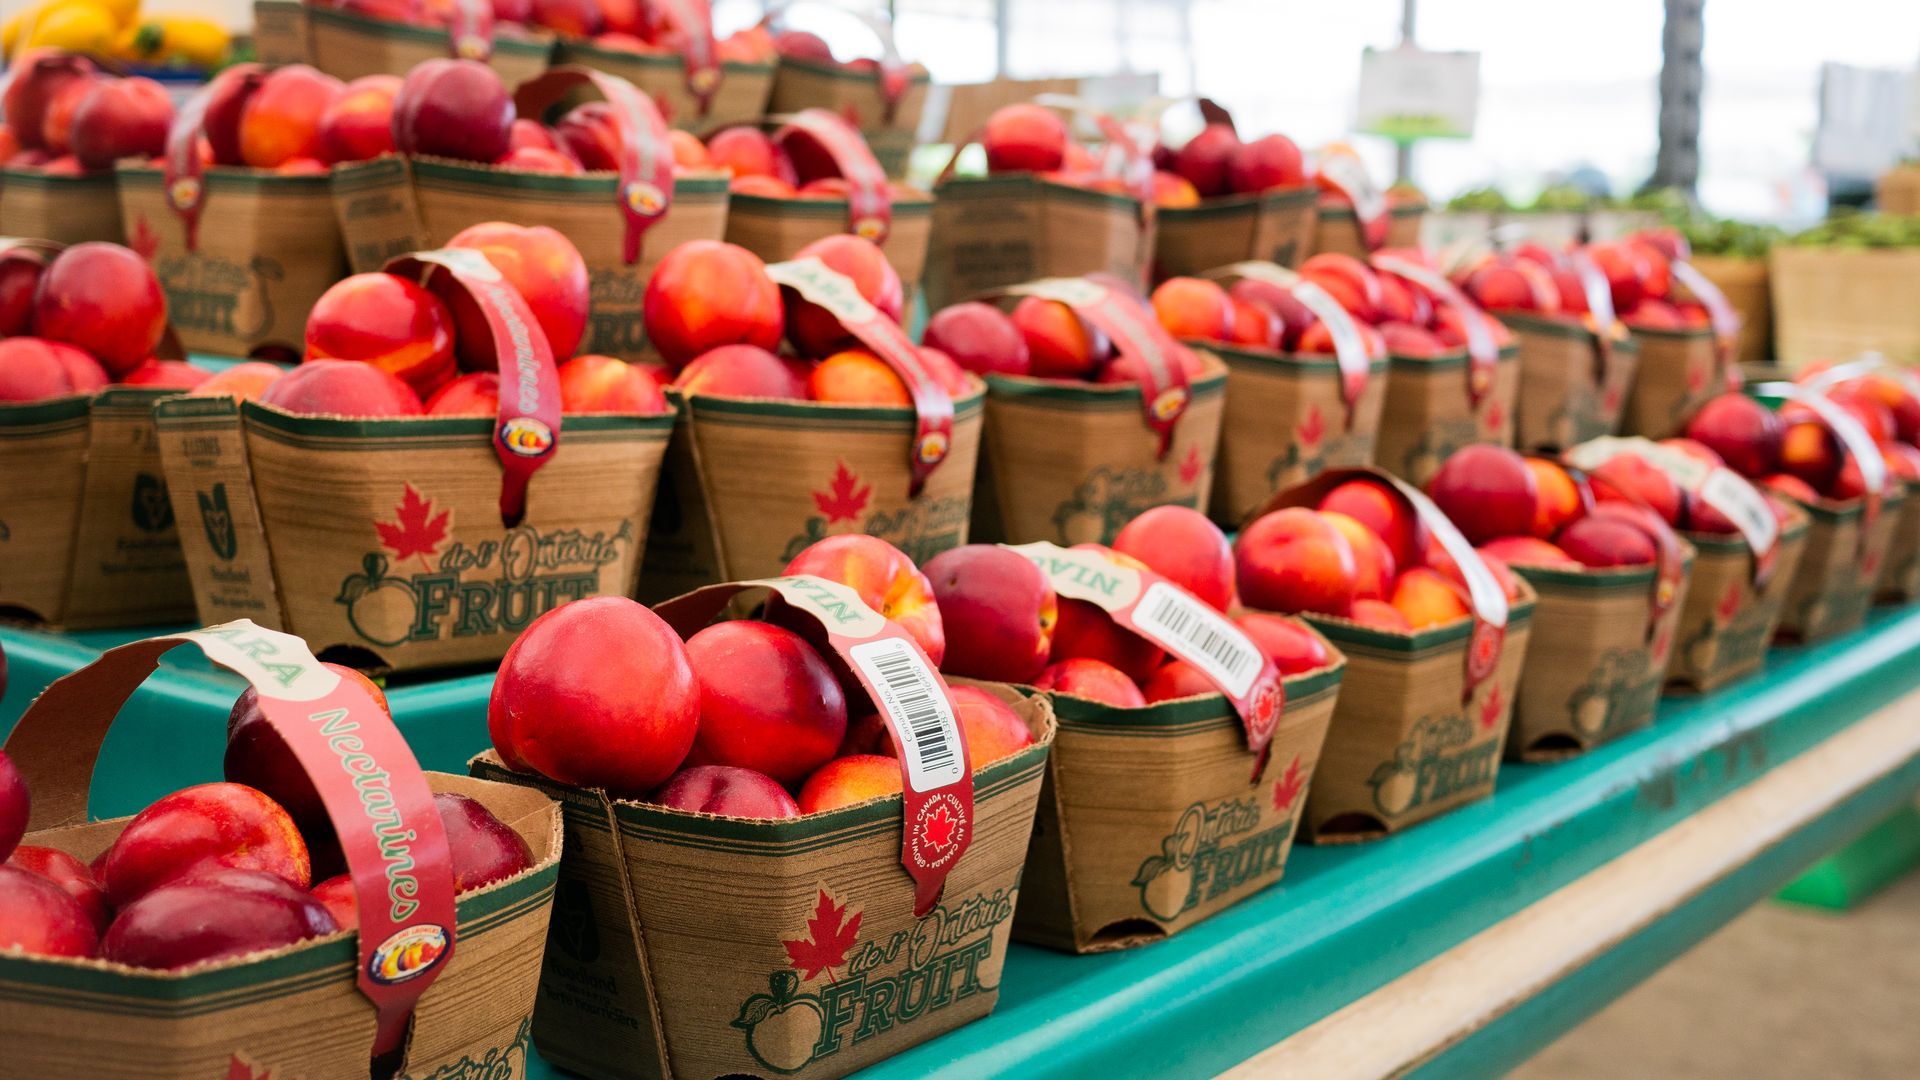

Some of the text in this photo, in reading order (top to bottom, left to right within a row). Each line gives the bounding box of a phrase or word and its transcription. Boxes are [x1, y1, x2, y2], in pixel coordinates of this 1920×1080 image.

[410, 571, 599, 641] FRUIT
[892, 704, 913, 743] Canada
[308, 707, 420, 923] Nectarines
[911, 793, 942, 868] GROWN IN CANADA
[931, 793, 967, 869] CULTIVÉ AU CANADA
[1180, 819, 1293, 913] FRUIT
[848, 937, 883, 976] de
[813, 934, 993, 1061] FRUIT
